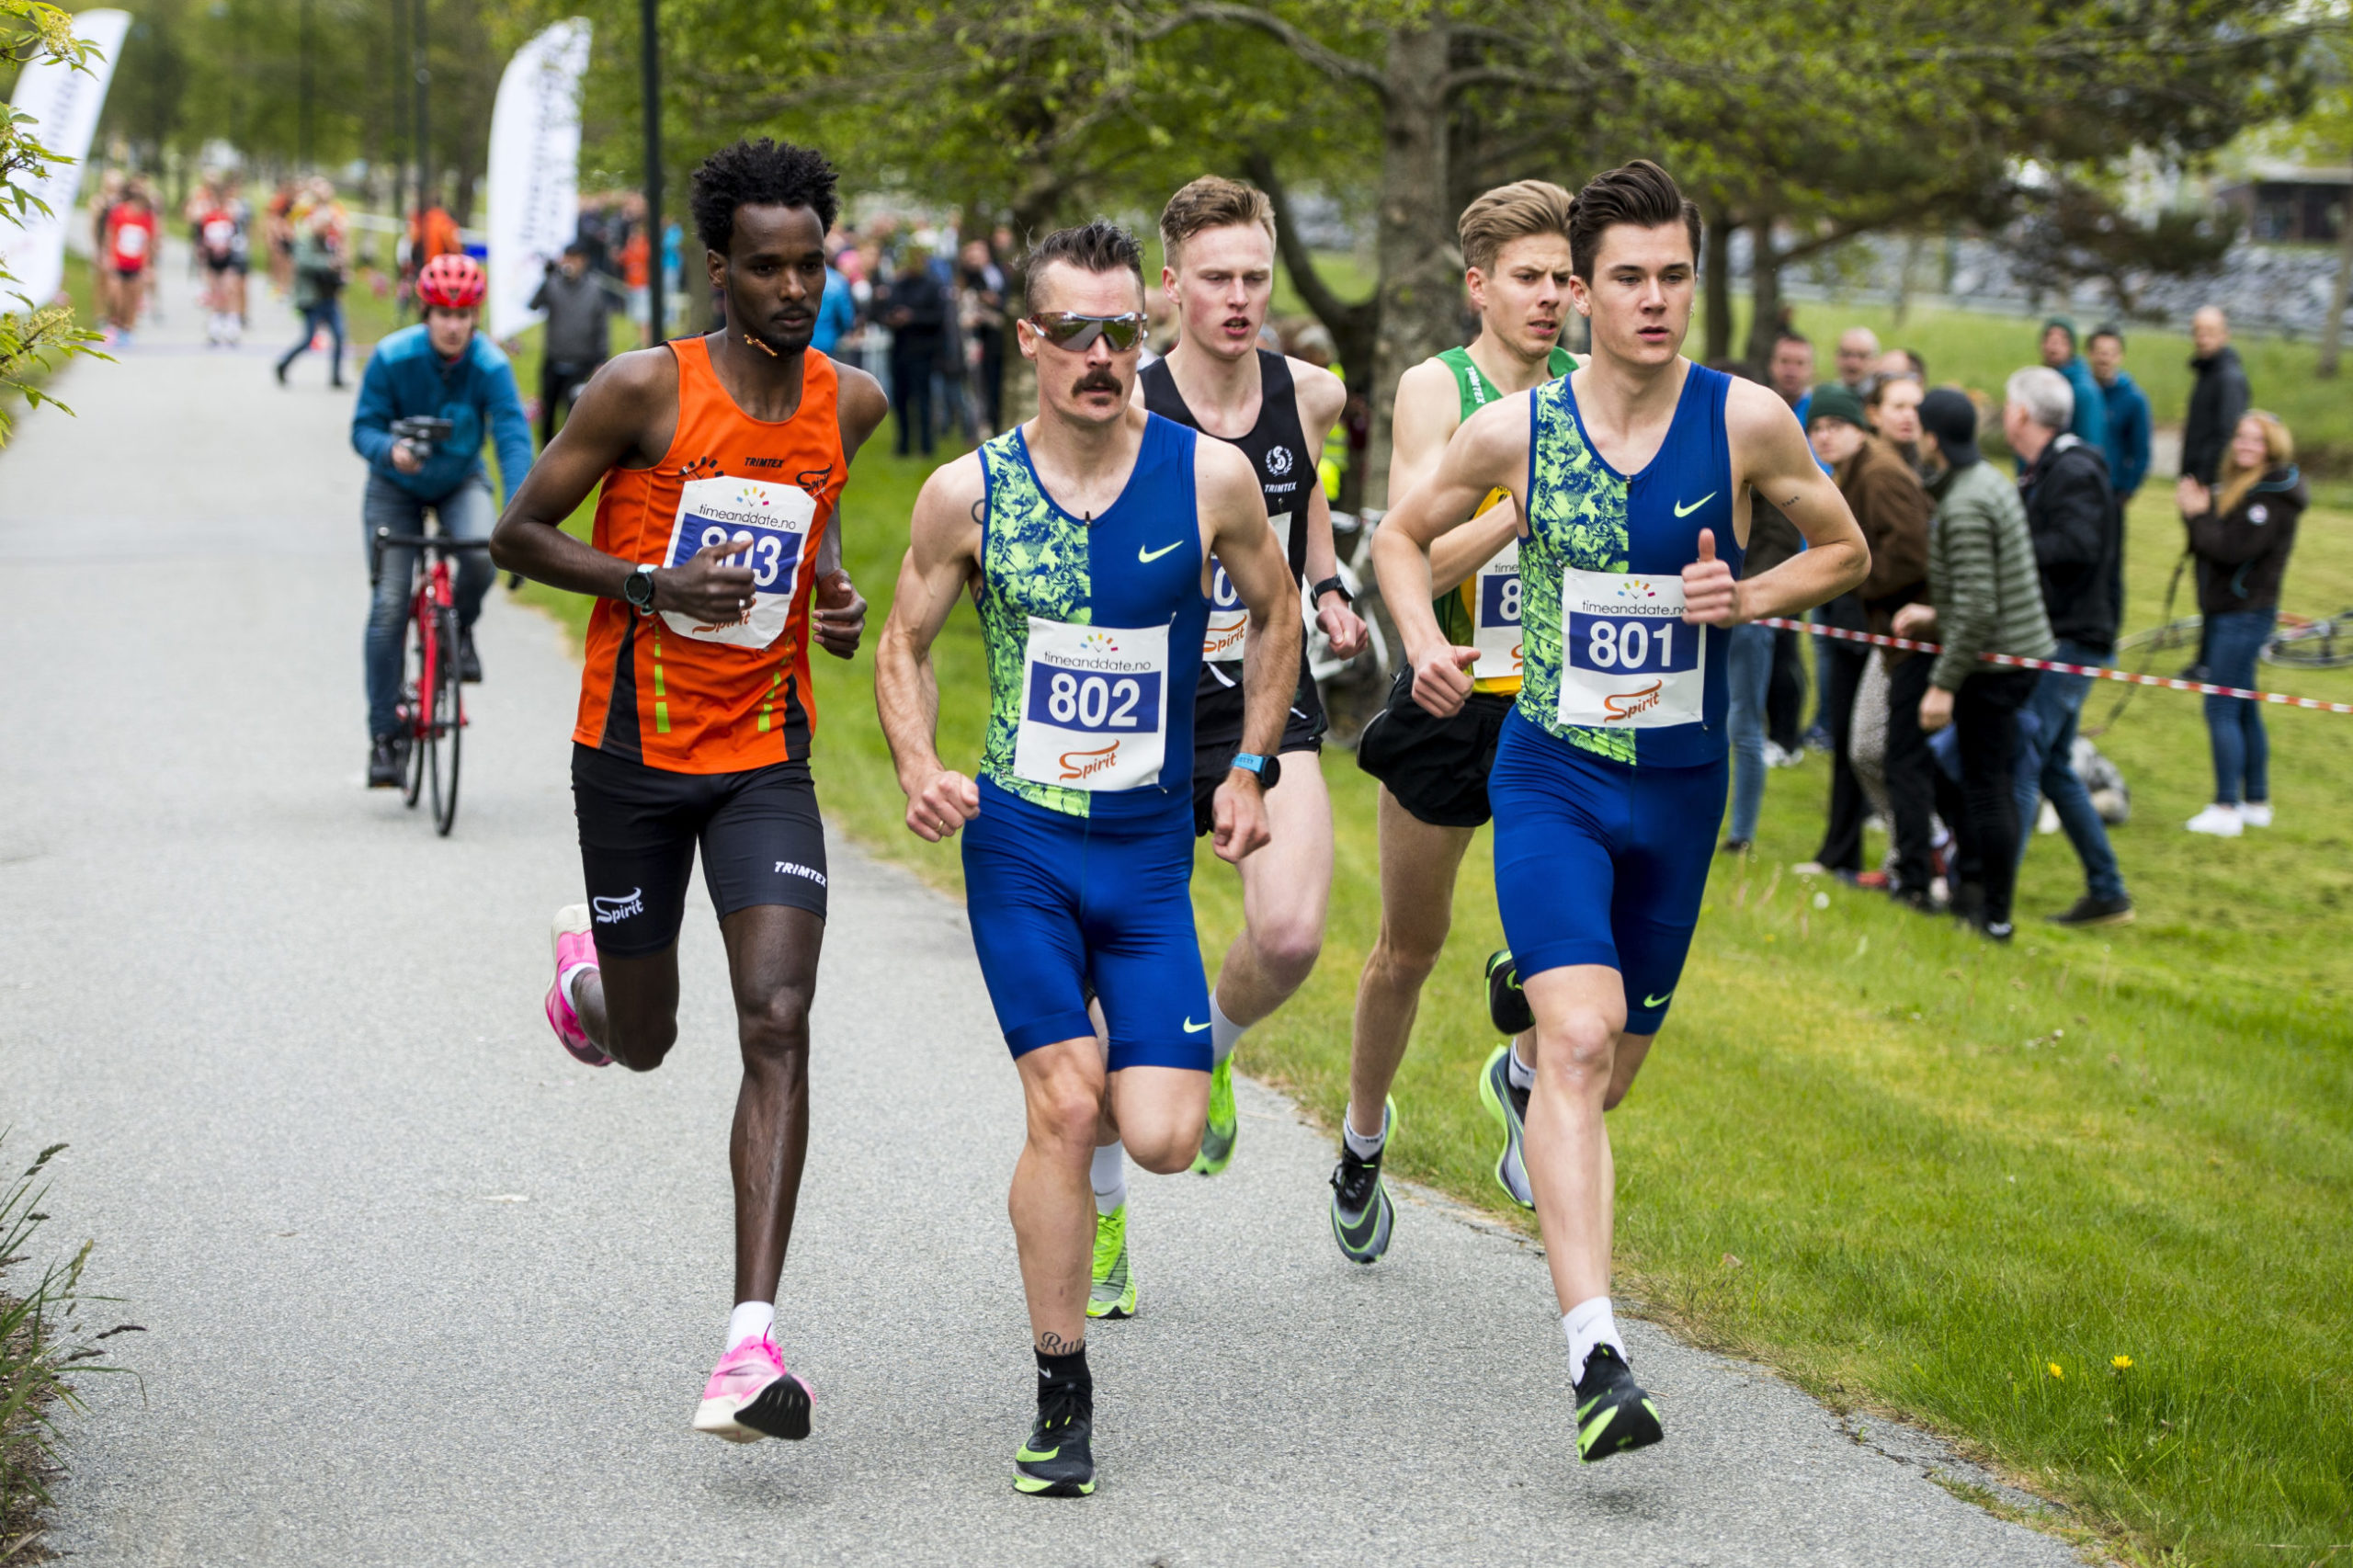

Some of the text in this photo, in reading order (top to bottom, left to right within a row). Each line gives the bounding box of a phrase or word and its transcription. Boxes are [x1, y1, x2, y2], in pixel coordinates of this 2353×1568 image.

[745, 457, 784, 469] TRIMTEX
[1265, 482, 1297, 493] TRIMTEX
[699, 503, 797, 530] timeanddate.no
[1588, 620, 1674, 669] 801
[1044, 651, 1152, 672] timeanddate.no
[1048, 672, 1141, 728] 802
[1604, 678, 1663, 723] Spirit
[1059, 739, 1120, 782] Spirit
[775, 861, 827, 889] TRIMTEX
[593, 887, 644, 924] Spirit
